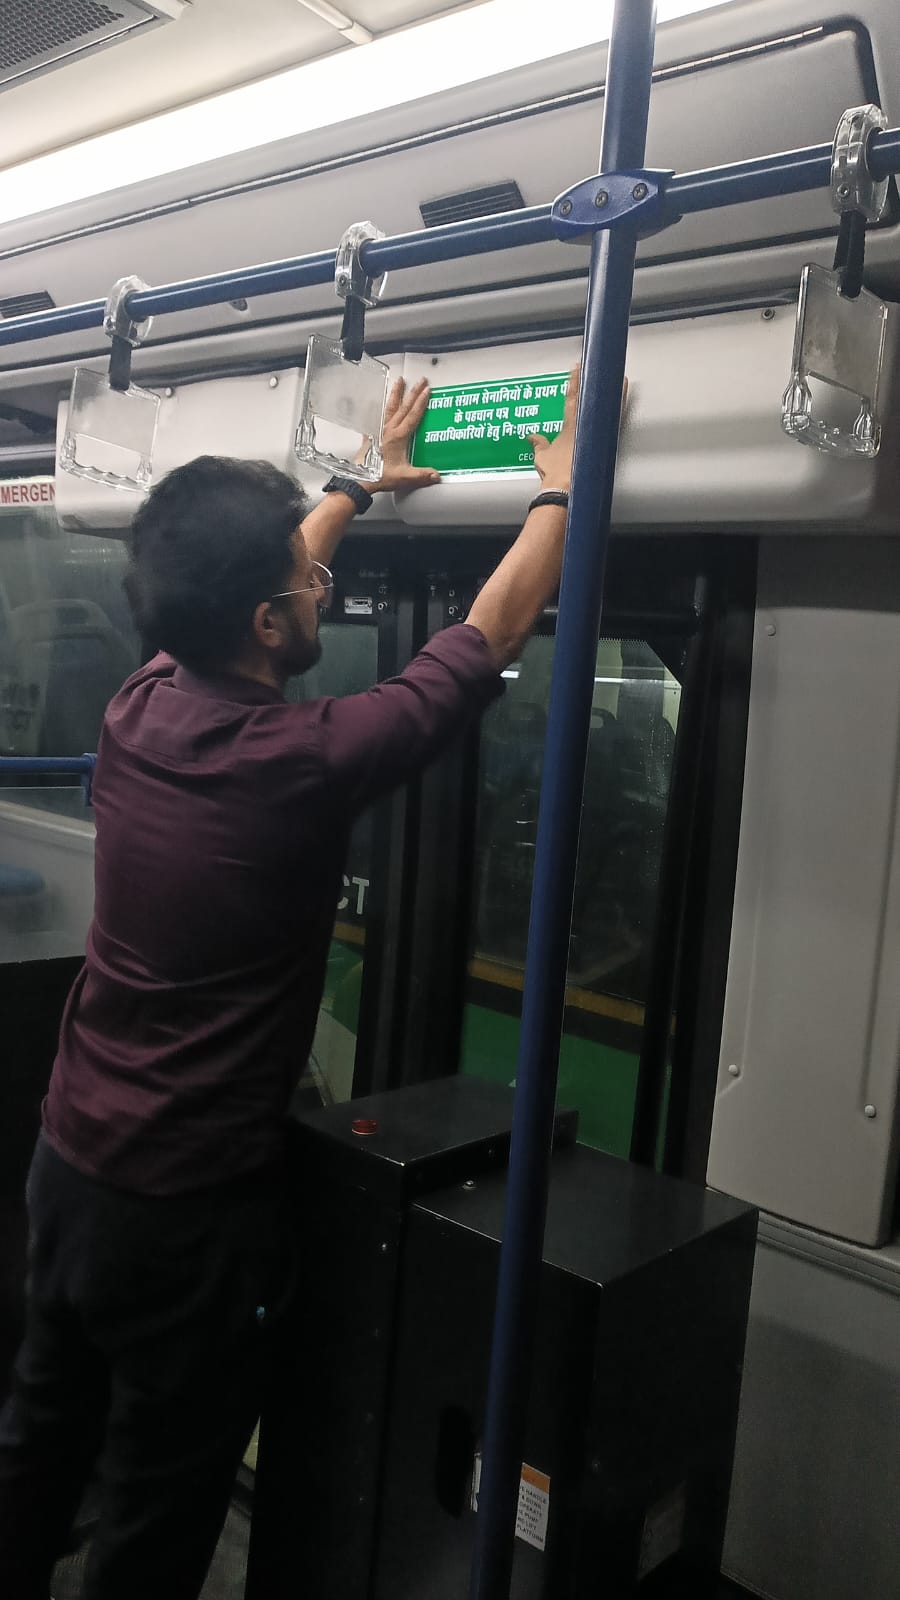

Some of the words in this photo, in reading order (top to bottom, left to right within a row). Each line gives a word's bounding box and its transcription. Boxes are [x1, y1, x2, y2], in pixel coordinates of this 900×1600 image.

[455, 391, 481, 407] संग्राम
[482, 384, 522, 404] सेनानियों
[523, 383, 533, 400] के
[535, 384, 558, 400] प्रथम
[454, 408, 464, 423] के
[465, 408, 495, 422] पहचान
[496, 407, 509, 420] पत्र
[514, 404, 540, 418] धारक
[487, 422, 501, 441] हेतु
